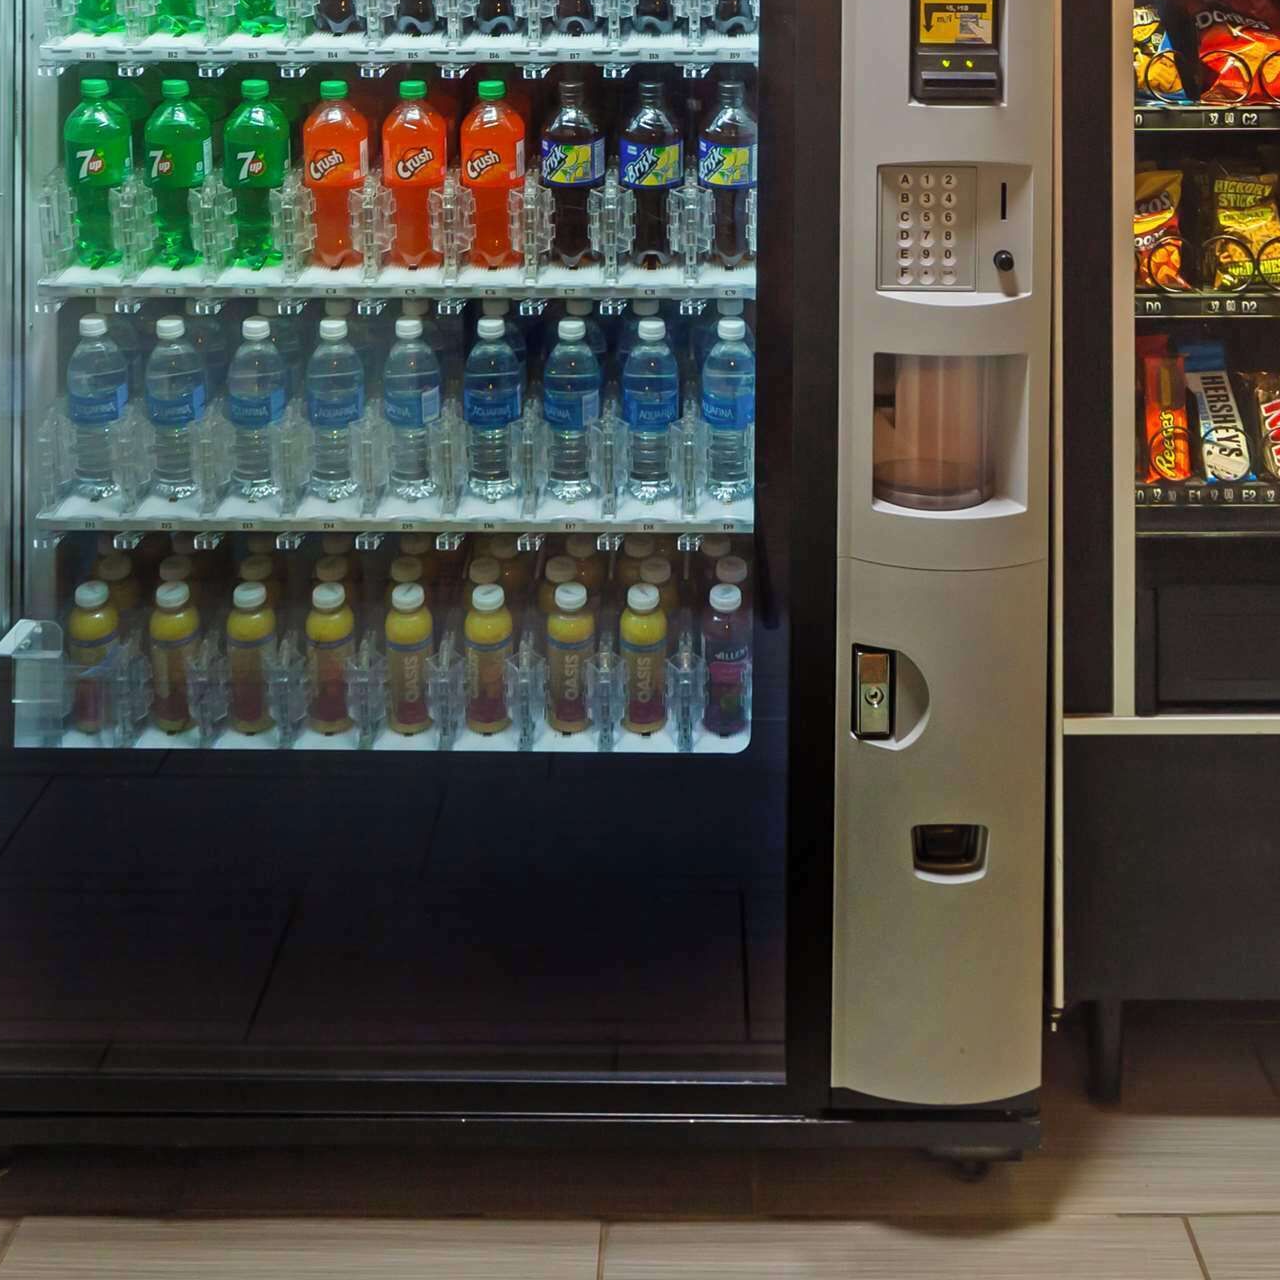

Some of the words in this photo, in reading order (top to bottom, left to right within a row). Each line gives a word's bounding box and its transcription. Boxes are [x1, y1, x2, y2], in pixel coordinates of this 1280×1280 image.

[1242, 113, 1258, 125] C2
[310, 150, 343, 179] Crush
[397, 148, 433, 179] Crush
[467, 150, 500, 179] Crush
[627, 146, 658, 180] Brisk
[1214, 180, 1272, 197] HICKORY
[1145, 301, 1161, 312] D0
[1241, 301, 1257, 312] D2
[1242, 490, 1257, 500] E2
[404, 655, 419, 702] OASIS
[564, 655, 579, 701] OASIS
[637, 656, 651, 703] OASIS
